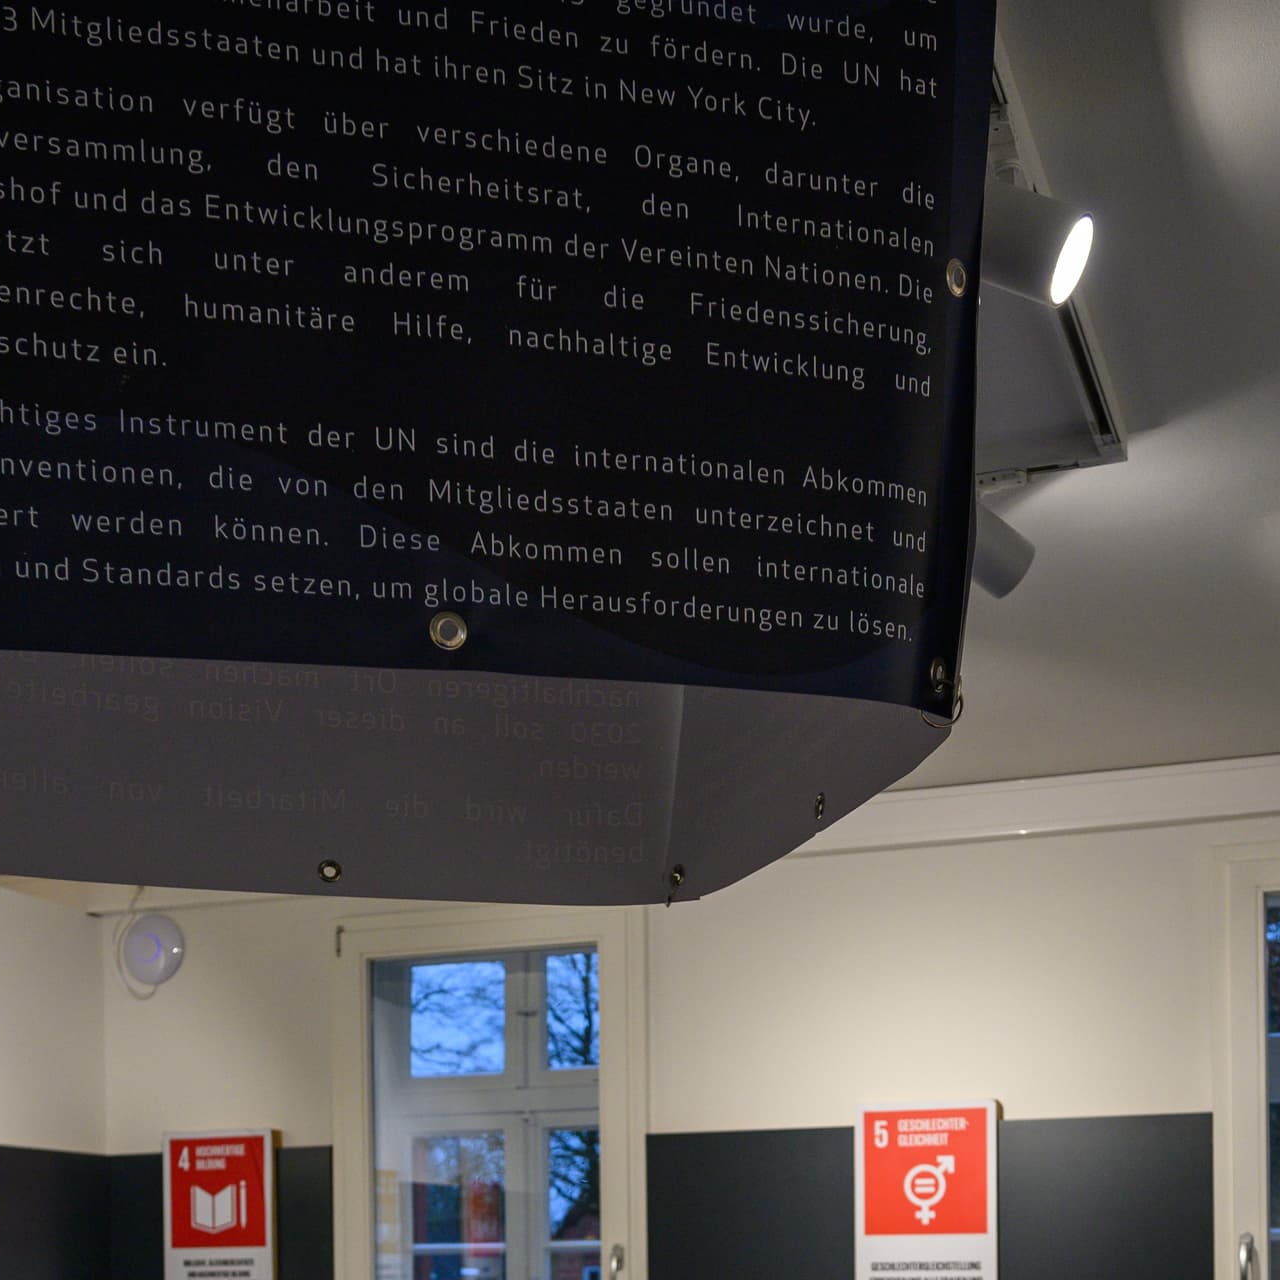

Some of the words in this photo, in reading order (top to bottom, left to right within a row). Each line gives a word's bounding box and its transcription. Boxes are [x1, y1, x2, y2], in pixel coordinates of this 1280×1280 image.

[31, 6, 300, 64] Mitgliedsstaaten
[312, 45, 363, 70] und
[375, 47, 422, 76] hat
[434, 55, 506, 87] ihren
[517, 64, 574, 96] Sitz
[584, 75, 607, 100] in
[619, 78, 676, 107] New
[687, 84, 747, 117] York
[758, 95, 816, 132] City.
[398, 6, 448, 31] und
[471, 10, 579, 49] Frieden
[599, 35, 629, 55] zu
[649, 34, 761, 72] fördern.
[781, 51, 823, 80] Die
[843, 59, 880, 88] UN
[900, 67, 937, 99] hat
[786, 11, 875, 44] wurde,
[904, 29, 938, 53] um
[182, 97, 296, 135] verfügt
[323, 111, 390, 140] über
[416, 125, 607, 165] verschiedene
[634, 144, 740, 183] Organe,
[764, 160, 879, 198] darunter
[902, 180, 935, 211] die
[74, 187, 127, 213] und
[140, 189, 192, 217] das
[205, 193, 553, 255] Entwicklungsprogramm
[564, 232, 610, 263] der
[620, 237, 755, 277] Vereinten
[765, 254, 891, 296] Nationen.
[899, 272, 934, 305] Die
[267, 151, 318, 182] den
[372, 162, 591, 214] Sicherheitsrat,
[641, 191, 689, 220] den
[738, 202, 934, 257] Internationalen
[102, 239, 163, 266] sich
[214, 251, 295, 277] unter
[343, 261, 469, 293] anderem
[515, 274, 558, 302] für
[603, 284, 645, 311] die
[690, 291, 932, 356] Friedenssicherung,
[113, 341, 167, 367] ein.
[184, 292, 355, 333] humanitäre
[393, 311, 472, 345] Hilfe,
[509, 327, 672, 367] nachhaltige
[706, 341, 865, 391] Entwicklung
[895, 373, 931, 398] und
[119, 407, 288, 445] Instrument
[307, 421, 356, 449] der
[375, 425, 416, 453] UN
[436, 432, 495, 460] sind
[513, 438, 555, 465] die
[574, 444, 785, 486] internationalen
[802, 464, 927, 508] Abkommen
[71, 509, 183, 537] werden
[214, 513, 329, 547] können.
[359, 523, 440, 552] Diese
[470, 530, 622, 566] Abkommen
[651, 546, 730, 575] sollen
[757, 555, 925, 599] internationale
[208, 464, 253, 492] die
[277, 476, 328, 497] von
[353, 474, 404, 501] den
[428, 478, 673, 521] Mitgliedsstaaten
[695, 506, 875, 543] unterzeichnet
[892, 529, 926, 553] und
[15, 556, 70, 582] und
[82, 557, 241, 591] Standards
[253, 572, 360, 601] setzen,
[372, 581, 413, 600] um
[424, 577, 529, 608] globale
[540, 584, 803, 633] Herausforderungen
[812, 612, 839, 631] zu
[849, 609, 913, 643] lösen.
[178, 1146, 190, 1172] 4
[874, 1119, 889, 1149] 5
